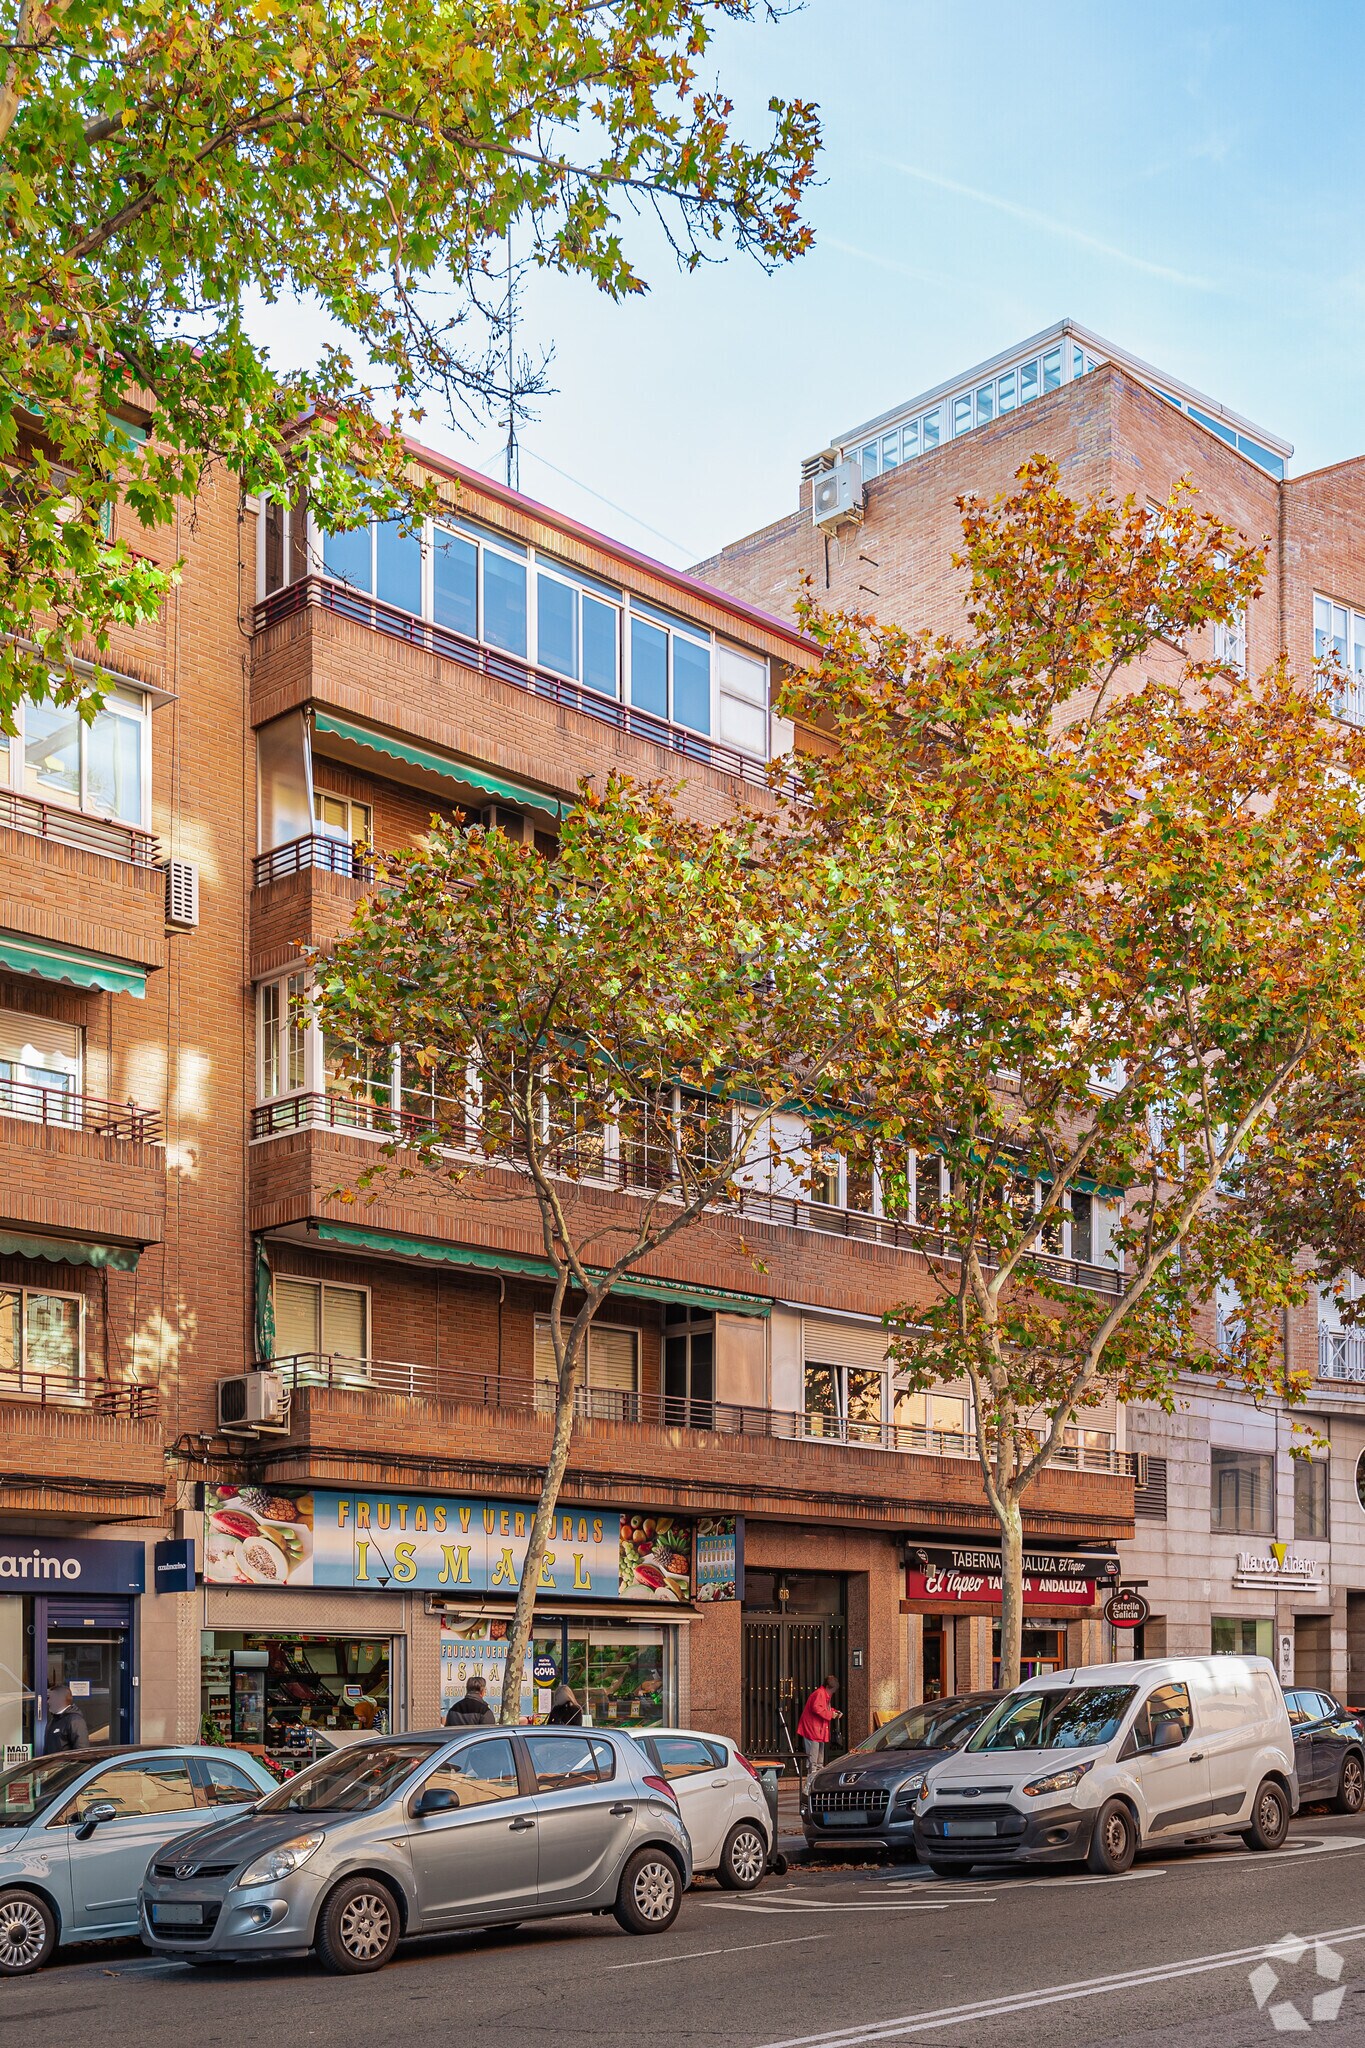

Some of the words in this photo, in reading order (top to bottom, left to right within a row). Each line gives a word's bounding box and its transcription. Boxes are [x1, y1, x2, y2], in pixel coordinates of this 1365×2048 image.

[337, 1501, 448, 1533] FRUTAS
[458, 1507, 471, 1534] Y
[482, 1508, 604, 1543] VERURAS
[700, 1539, 727, 1551] FRUTAS
[728, 1539, 733, 1550] Y
[699, 1549, 735, 1563] VERDURAS
[951, 1551, 1002, 1569] TABERNA
[1058, 1558, 1068, 1572] El
[1067, 1559, 1086, 1575] Tapeo
[0, 1548, 82, 1580] arino
[699, 1563, 735, 1579] ISMAEL
[1238, 1551, 1279, 1573] Marco
[1281, 1555, 1318, 1578] Aldany
[925, 1568, 947, 1594] El
[946, 1569, 985, 1600] Tapeo
[1039, 1578, 1088, 1594] ANDALUZA
[1112, 1602, 1140, 1611] Estrella
[1112, 1610, 1139, 1619] Galicia
[441, 1645, 477, 1659] FRUTAS
[478, 1646, 484, 1659] Y
[534, 1667, 556, 1677] GOYA
[7, 1745, 29, 1753] MAD
